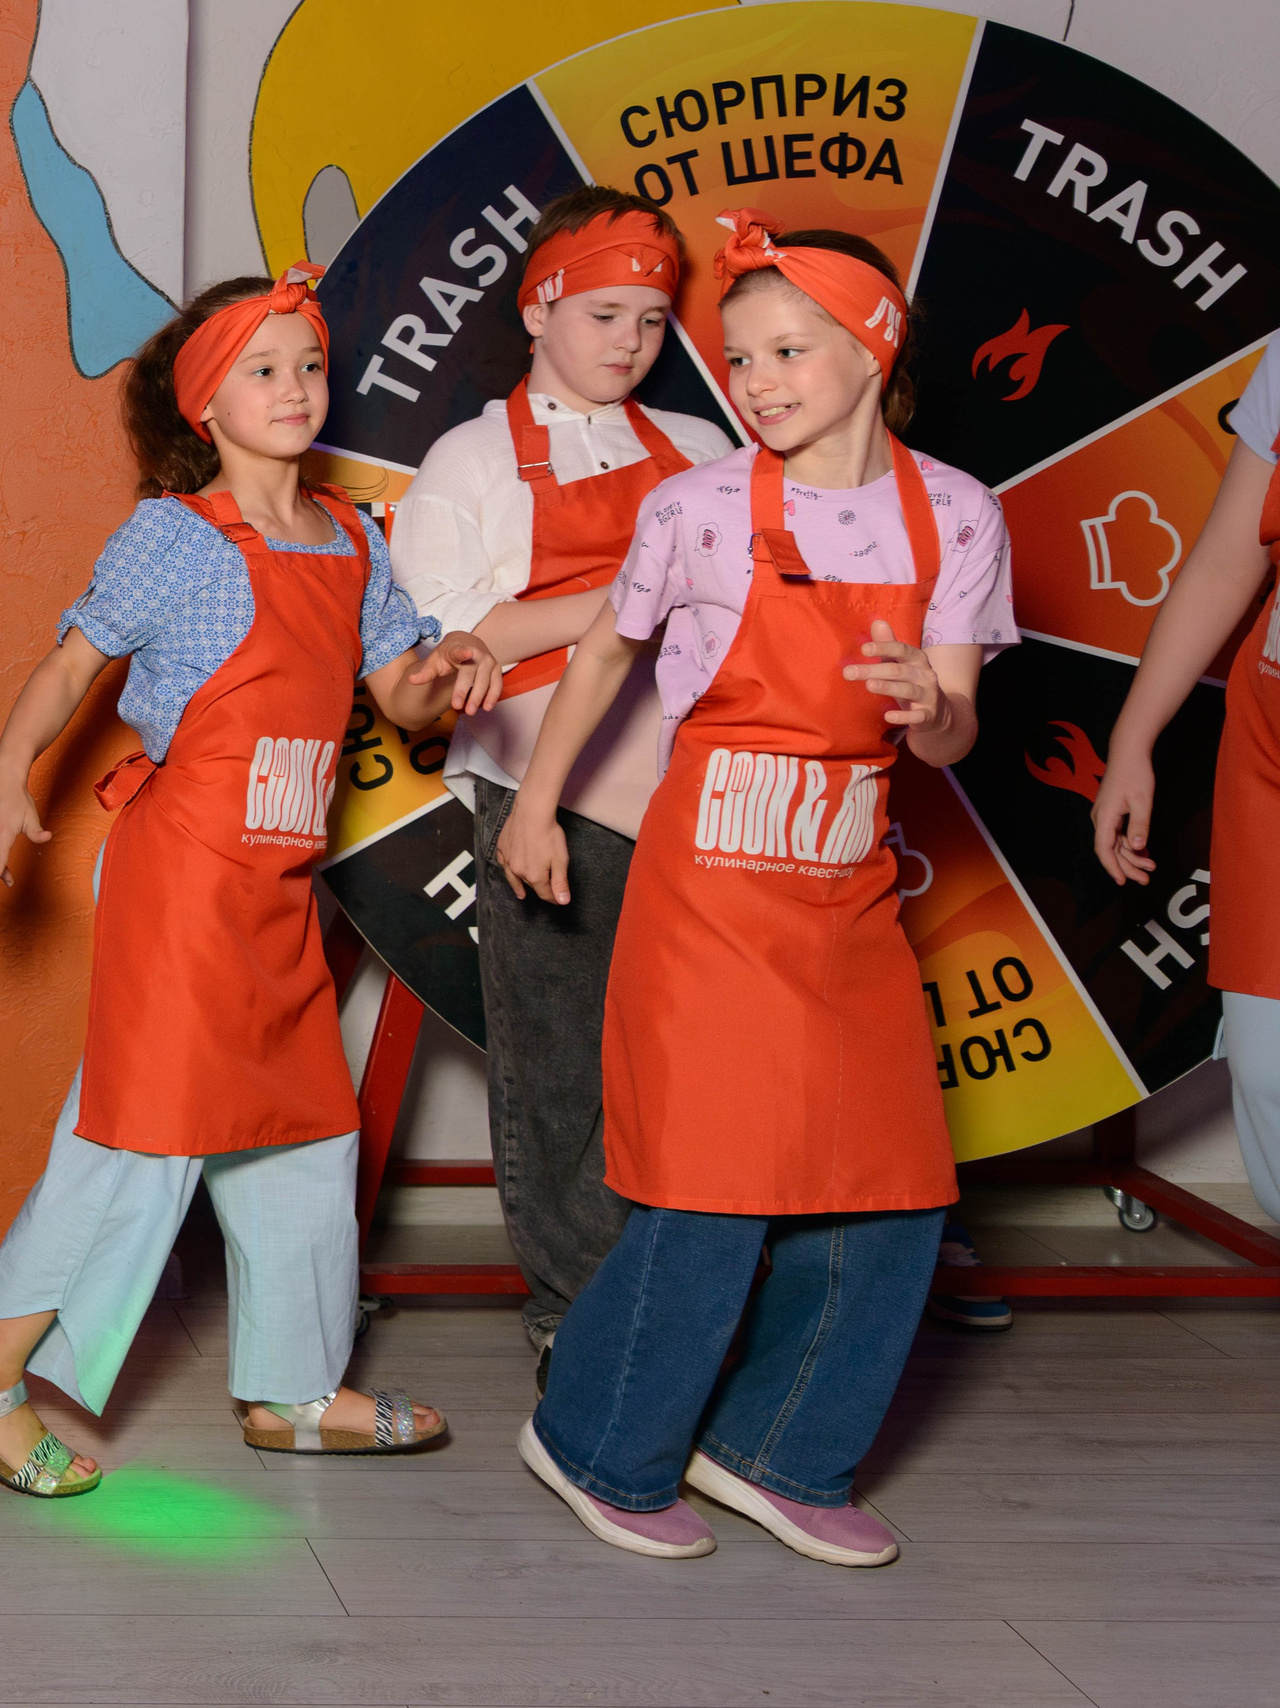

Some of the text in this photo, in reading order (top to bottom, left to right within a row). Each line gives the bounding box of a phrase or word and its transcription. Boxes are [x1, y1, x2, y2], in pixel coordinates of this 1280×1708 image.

[620, 73, 908, 148] СЮРПРИЗ
[634, 132, 904, 208] ОТ ШЕФА
[1013, 118, 1248, 311] TRASH
[356, 184, 543, 403] TRASH
[245, 736, 322, 835] COOK
[695, 748, 799, 858] COOK
[241, 833, 313, 849] кулинарное
[694, 854, 796, 874] кулинарное
[965, 956, 1034, 1019] ОТ
